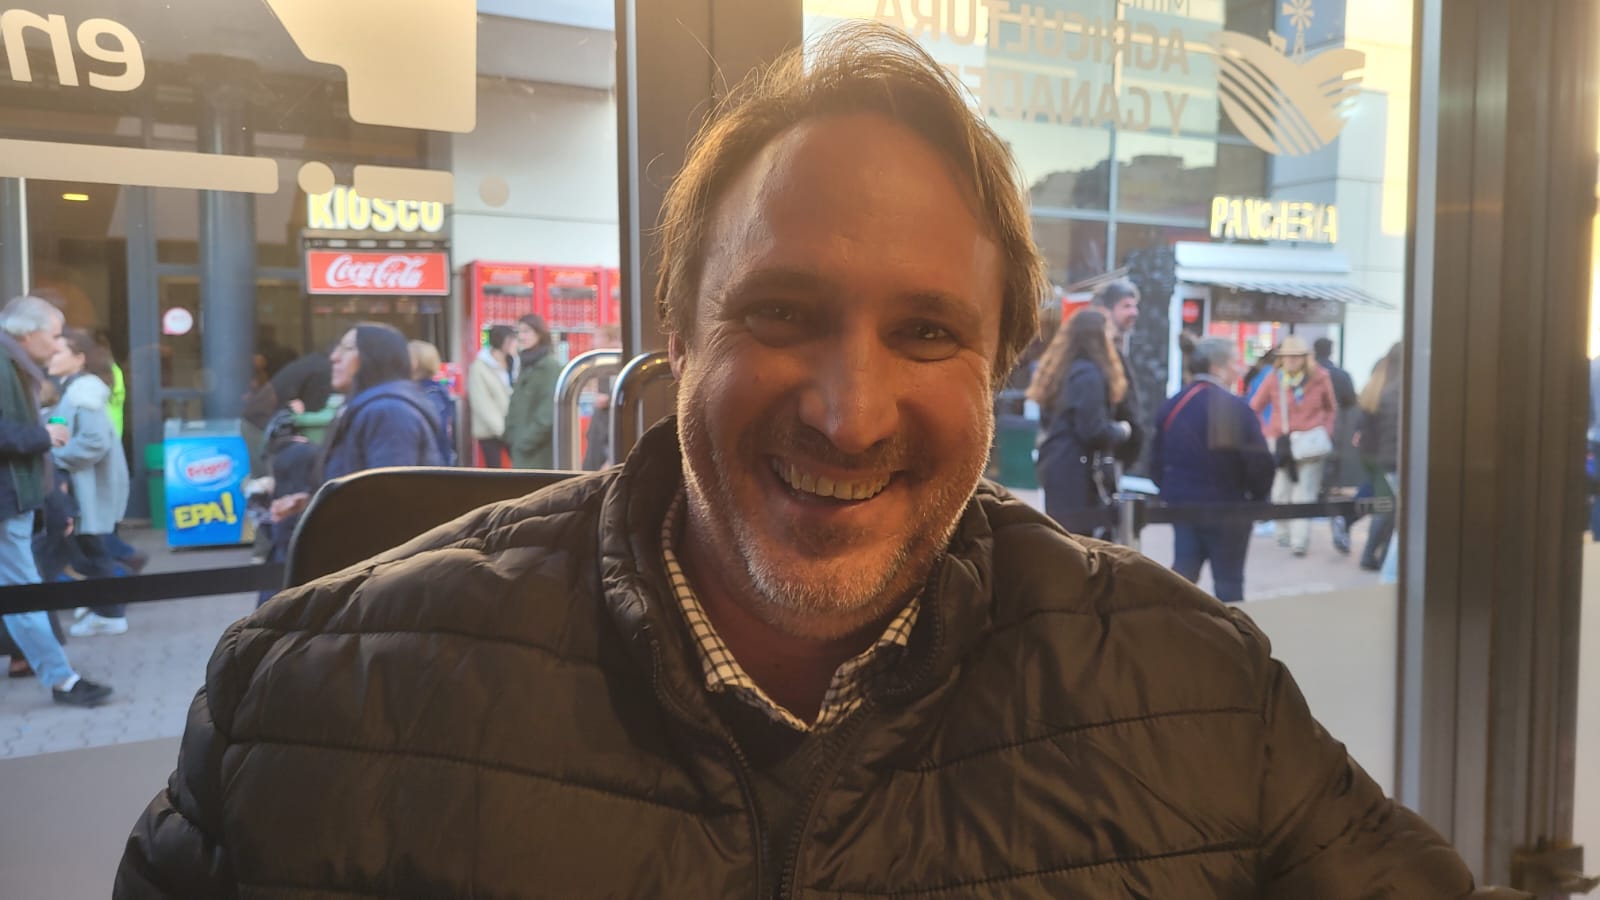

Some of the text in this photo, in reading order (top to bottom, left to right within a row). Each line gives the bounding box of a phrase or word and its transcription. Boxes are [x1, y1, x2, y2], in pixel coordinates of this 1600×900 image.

[308, 187, 443, 232] KIOSCO
[1210, 196, 1338, 244] PANCHERIA
[173, 491, 237, 529] EPA!
